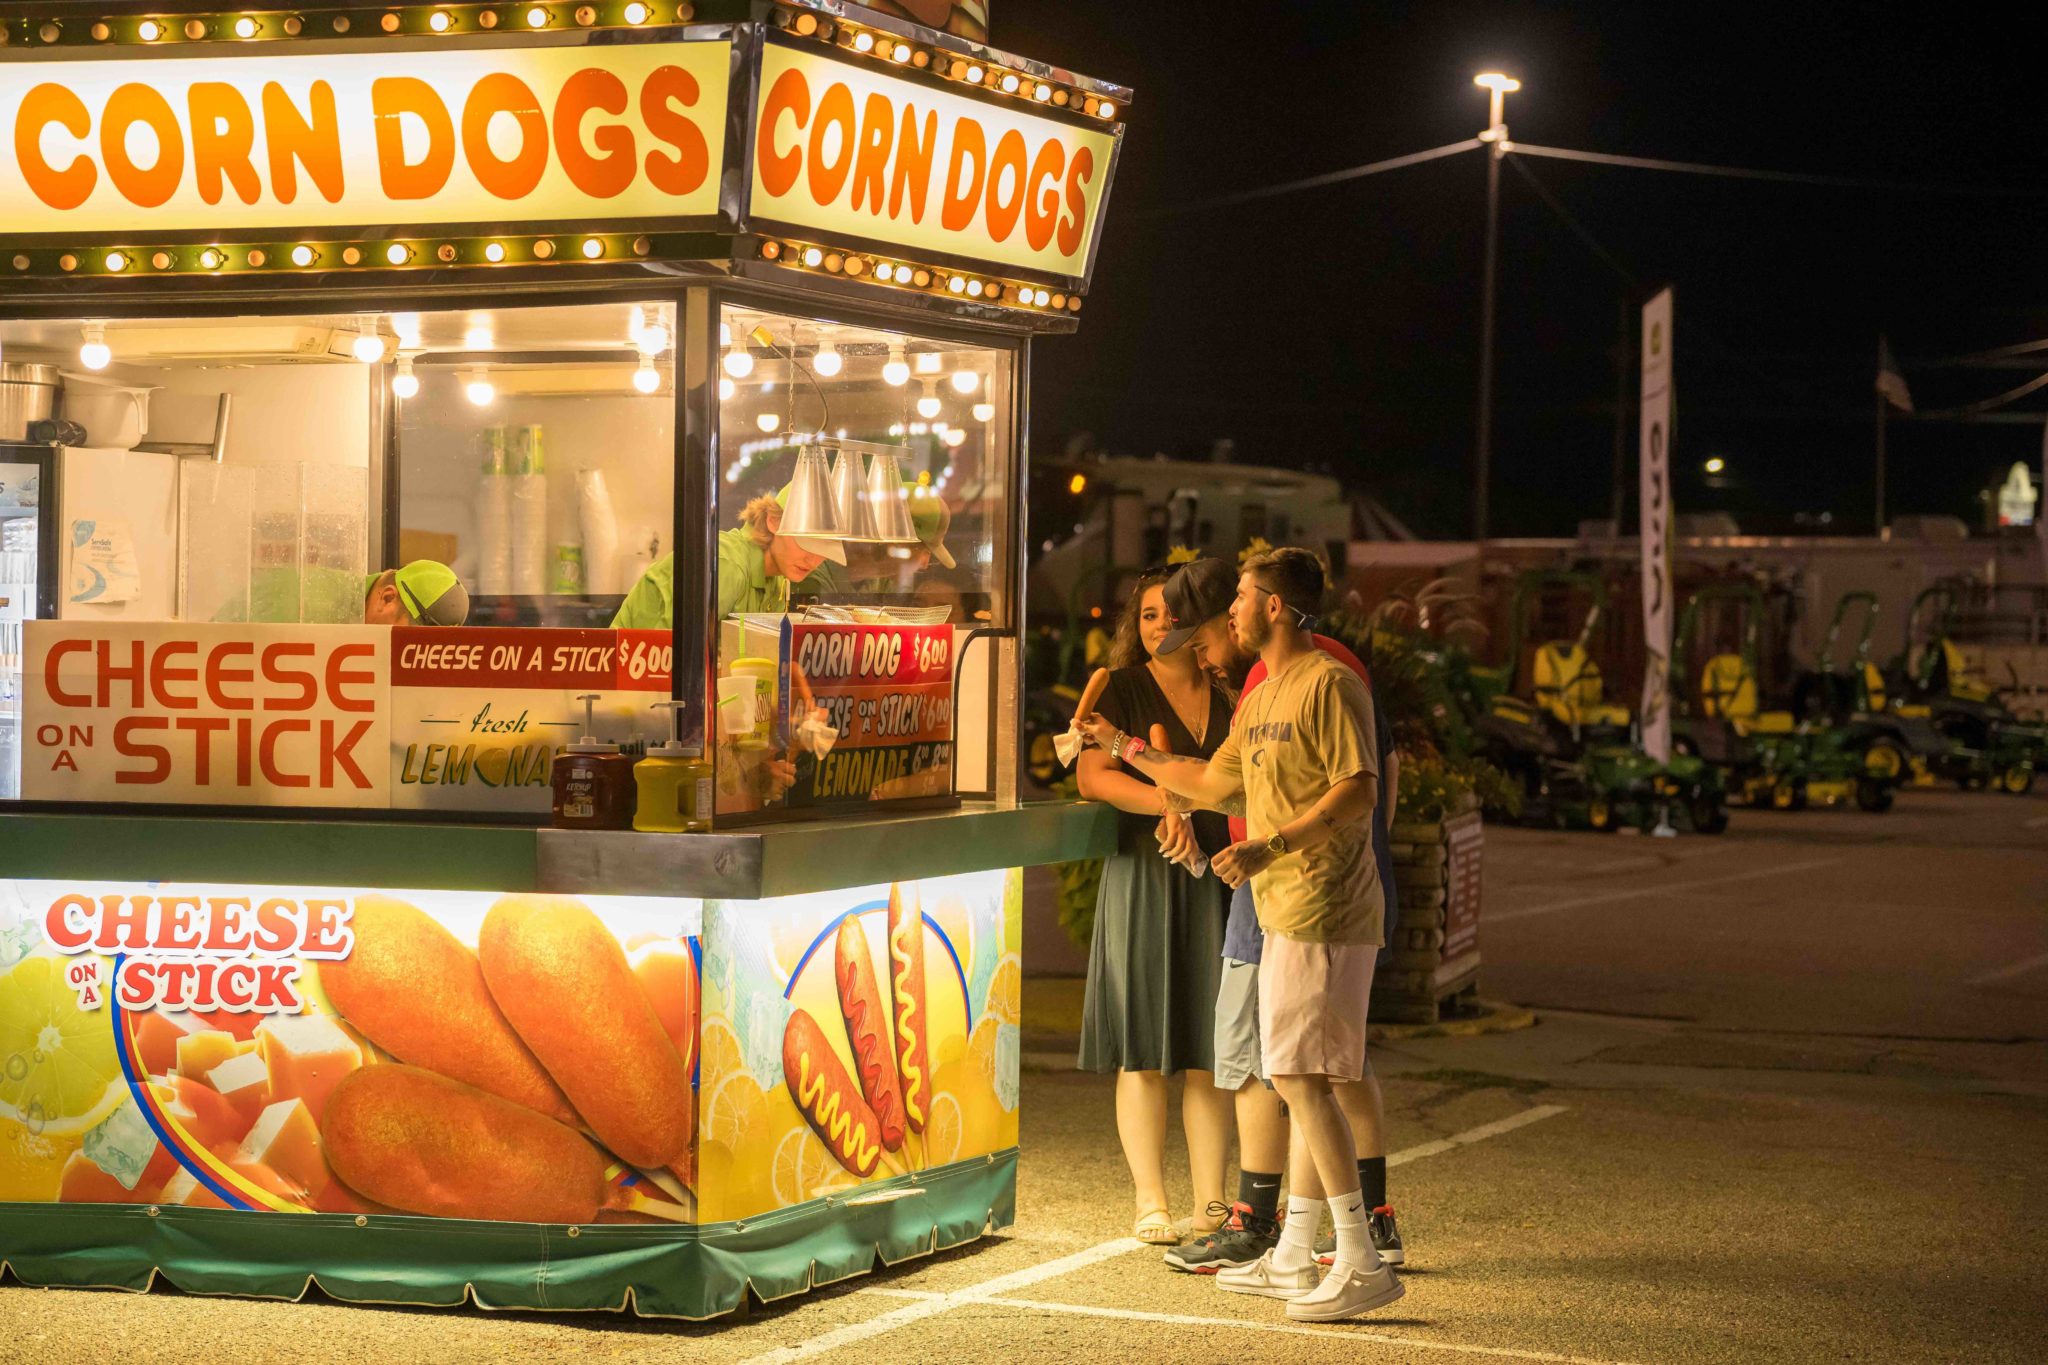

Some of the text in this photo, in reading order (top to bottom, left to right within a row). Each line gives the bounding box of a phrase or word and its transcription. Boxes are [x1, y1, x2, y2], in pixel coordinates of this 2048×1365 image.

[14, 65, 709, 211] CORN DOGS
[758, 68, 1094, 257] CORN DOGS
[400, 644, 484, 670] CHEESE
[489, 645, 521, 671] ON
[526, 646, 543, 672] A
[551, 647, 615, 672] STICK
[799, 632, 857, 677] CORN
[860, 632, 902, 677] DOG
[44, 639, 375, 712] CHEESE
[470, 702, 529, 733] fresh
[859, 700, 877, 716] ON
[862, 717, 872, 733] A
[877, 693, 923, 736] STICK
[36, 724, 93, 747] ON
[113, 716, 374, 789] STICK
[51, 749, 79, 772] A
[46, 893, 348, 954] CHEESE
[70, 963, 97, 984] ON
[122, 962, 299, 1008] STICK
[83, 986, 97, 1004] A
